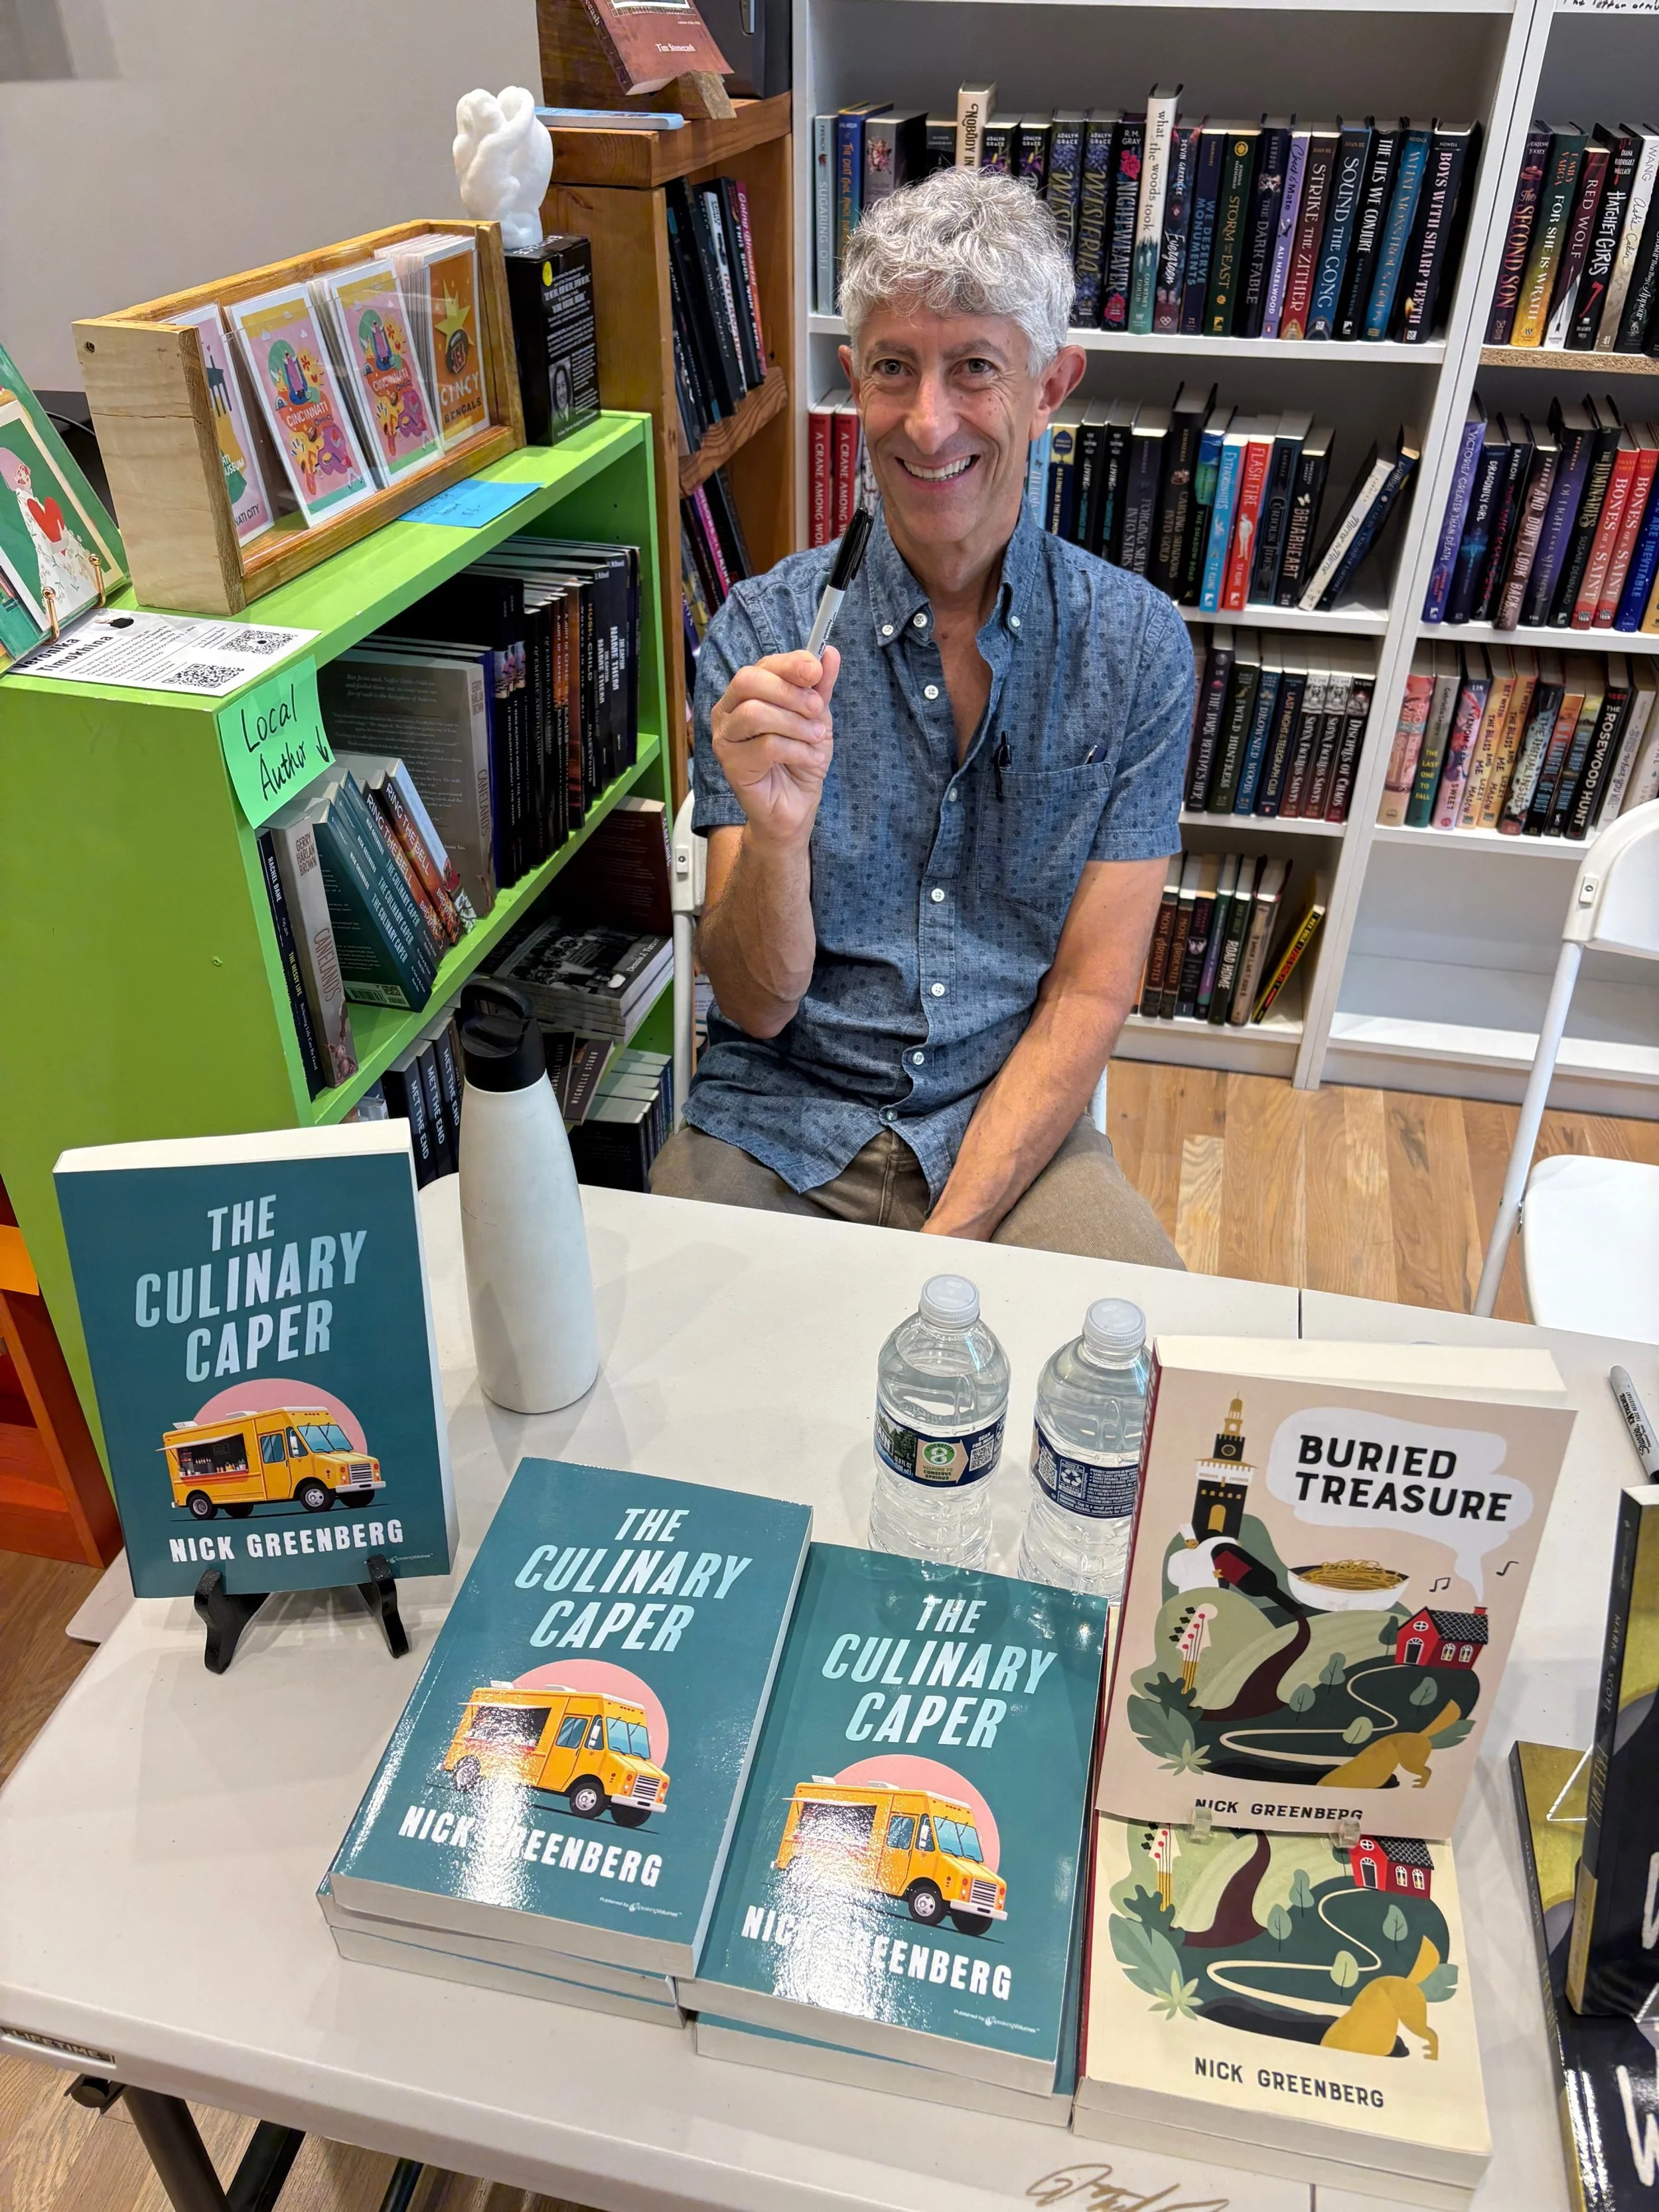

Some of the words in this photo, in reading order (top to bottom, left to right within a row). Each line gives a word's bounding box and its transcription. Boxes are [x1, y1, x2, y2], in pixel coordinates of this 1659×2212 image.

[656, 43, 669, 52] Tim
[1157, 111, 1168, 138] what
[1149, 142, 1161, 161] the
[1376, 139, 1393, 157] THE
[1642, 145, 1659, 182] WANG
[1147, 163, 1159, 202] woods
[1371, 161, 1388, 183] LIES
[1435, 152, 1453, 187] BOYS
[1304, 163, 1327, 222] STRIKE
[1334, 157, 1360, 222] SOUND
[1367, 187, 1384, 205] WE
[1582, 179, 1599, 210] RED
[1143, 204, 1155, 231] took
[1224, 196, 1240, 241] STORM
[1427, 190, 1445, 232] WITH
[1598, 190, 1626, 241] HATCHET
[1106, 181, 1138, 291] NIGHTWEAVER
[1188, 197, 1205, 286] MONUMENTS
[1301, 227, 1315, 250] THE
[1329, 226, 1344, 252] THE
[1356, 210, 1379, 254] CONJURE
[1571, 217, 1591, 259] WOLF
[1165, 231, 1186, 285] Evergreen
[1277, 246, 1285, 259] ALI
[1418, 232, 1437, 277] SHARP
[1589, 238, 1616, 276] GIRLS
[1219, 256, 1234, 289] EAST
[1268, 259, 1283, 315] HAZELWOOD
[1289, 254, 1312, 312] ZITHER
[1317, 257, 1340, 308] GONG
[1409, 279, 1429, 324] TEETH
[372, 370, 409, 391] CINCINNATI
[439, 371, 480, 406] CINCY
[287, 402, 329, 427] CINCINNATI
[444, 397, 482, 423] BENGALS
[839, 445, 849, 479] CRANE
[1082, 463, 1092, 487] LIVING
[1108, 463, 1118, 487] LIVING
[1247, 447, 1265, 480] FLASH
[1508, 449, 1521, 481] BAYRON
[1602, 451, 1611, 463] THE
[1243, 483, 1260, 506] FIRE
[1479, 460, 1498, 505] DRAGONFLY
[1532, 488, 1548, 512] AND
[1579, 463, 1613, 528] LUMINARIES
[246, 504, 259, 523] CITY
[838, 482, 849, 521] AMONG
[1476, 506, 1488, 522] GIRL
[1137, 498, 1152, 544] FORGING
[1524, 515, 1541, 549] DON'T
[1281, 507, 1311, 579] BRIARHEART
[1513, 550, 1532, 579] LOOK
[1632, 540, 1656, 597] INEVITABLE
[1506, 581, 1523, 609] BACK
[13, 638, 81, 670] Veronika
[36, 636, 114, 672] Timokhina
[241, 684, 297, 753] Local
[1232, 705, 1246, 733] WILD
[1250, 705, 1269, 759] DROWNED
[1221, 735, 1240, 788] HUNTRESS
[1475, 759, 1484, 776] ME
[1496, 757, 1506, 773] ME
[1585, 713, 1616, 790] ROSEWOOD
[1243, 763, 1258, 794] WOODS
[1447, 782, 1459, 810] SWEET
[1484, 782, 1498, 810] MASON
[477, 769, 491, 837] CANELANDS
[1463, 785, 1477, 814] MASON
[1575, 790, 1593, 827] HUNT
[296, 832, 311, 851] GERRY
[366, 794, 384, 831] RING
[384, 830, 397, 855] THE
[396, 854, 412, 889] BELL
[386, 782, 403, 820] RING
[402, 815, 416, 844] THE
[414, 842, 429, 876] BELL
[297, 843, 315, 865] HARLAN
[299, 856, 317, 876] BROWN
[267, 857, 279, 887] RACHEL
[273, 887, 282, 903] BANE
[378, 875, 387, 892] THE
[384, 889, 402, 925] CULINARY
[399, 921, 413, 946] CAPER
[392, 874, 409, 909] CULINARY
[406, 903, 420, 928] CAPER
[372, 893, 380, 909] THE
[378, 908, 397, 944] CULINARY
[394, 939, 407, 964] CAPER
[314, 928, 341, 1001] CANELANDS
[1225, 939, 1240, 962] ROAD
[1218, 962, 1234, 990] HOME
[443, 1049, 454, 1070] MET
[427, 1066, 437, 1088] MET
[435, 1118, 445, 1142] END
[448, 1074, 457, 1097] THE
[410, 1081, 421, 1102] MET
[416, 1106, 426, 1130] THE
[207, 1195, 276, 1251] THE
[135, 1230, 368, 1328] CULINARY
[186, 1299, 333, 1383] CAPER
[978, 1432, 991, 1441] SCAN
[981, 1434, 995, 1445] MORE
[1297, 1434, 1457, 1479] BURIED
[1295, 1473, 1512, 1522] TREASURE
[169, 1535, 235, 1563] NICK
[247, 1518, 404, 1558] GREENBERG
[615, 1509, 689, 1542] THE
[514, 1544, 753, 1599] CULINARY
[529, 1600, 695, 1652] CAPER
[914, 1597, 987, 1634] THE
[1608, 1613, 1621, 1655] MARK
[821, 1633, 1058, 1694] CULINARY
[1605, 1669, 1616, 1714] SCOTT
[845, 1692, 1007, 1749] CAPER
[1194, 1798, 1240, 1814] NICK
[1250, 1802, 1364, 1821] GREENBERG
[398, 1805, 475, 1848] NICK
[491, 1817, 662, 1887] EENBERG
[741, 1905, 798, 1947] NIC
[856, 1931, 1012, 2000] EENBERG
[13, 2030, 99, 2057] LIFETIME
[1194, 2057, 1244, 2085] NICK
[1258, 2069, 1385, 2109] GREENBERG
